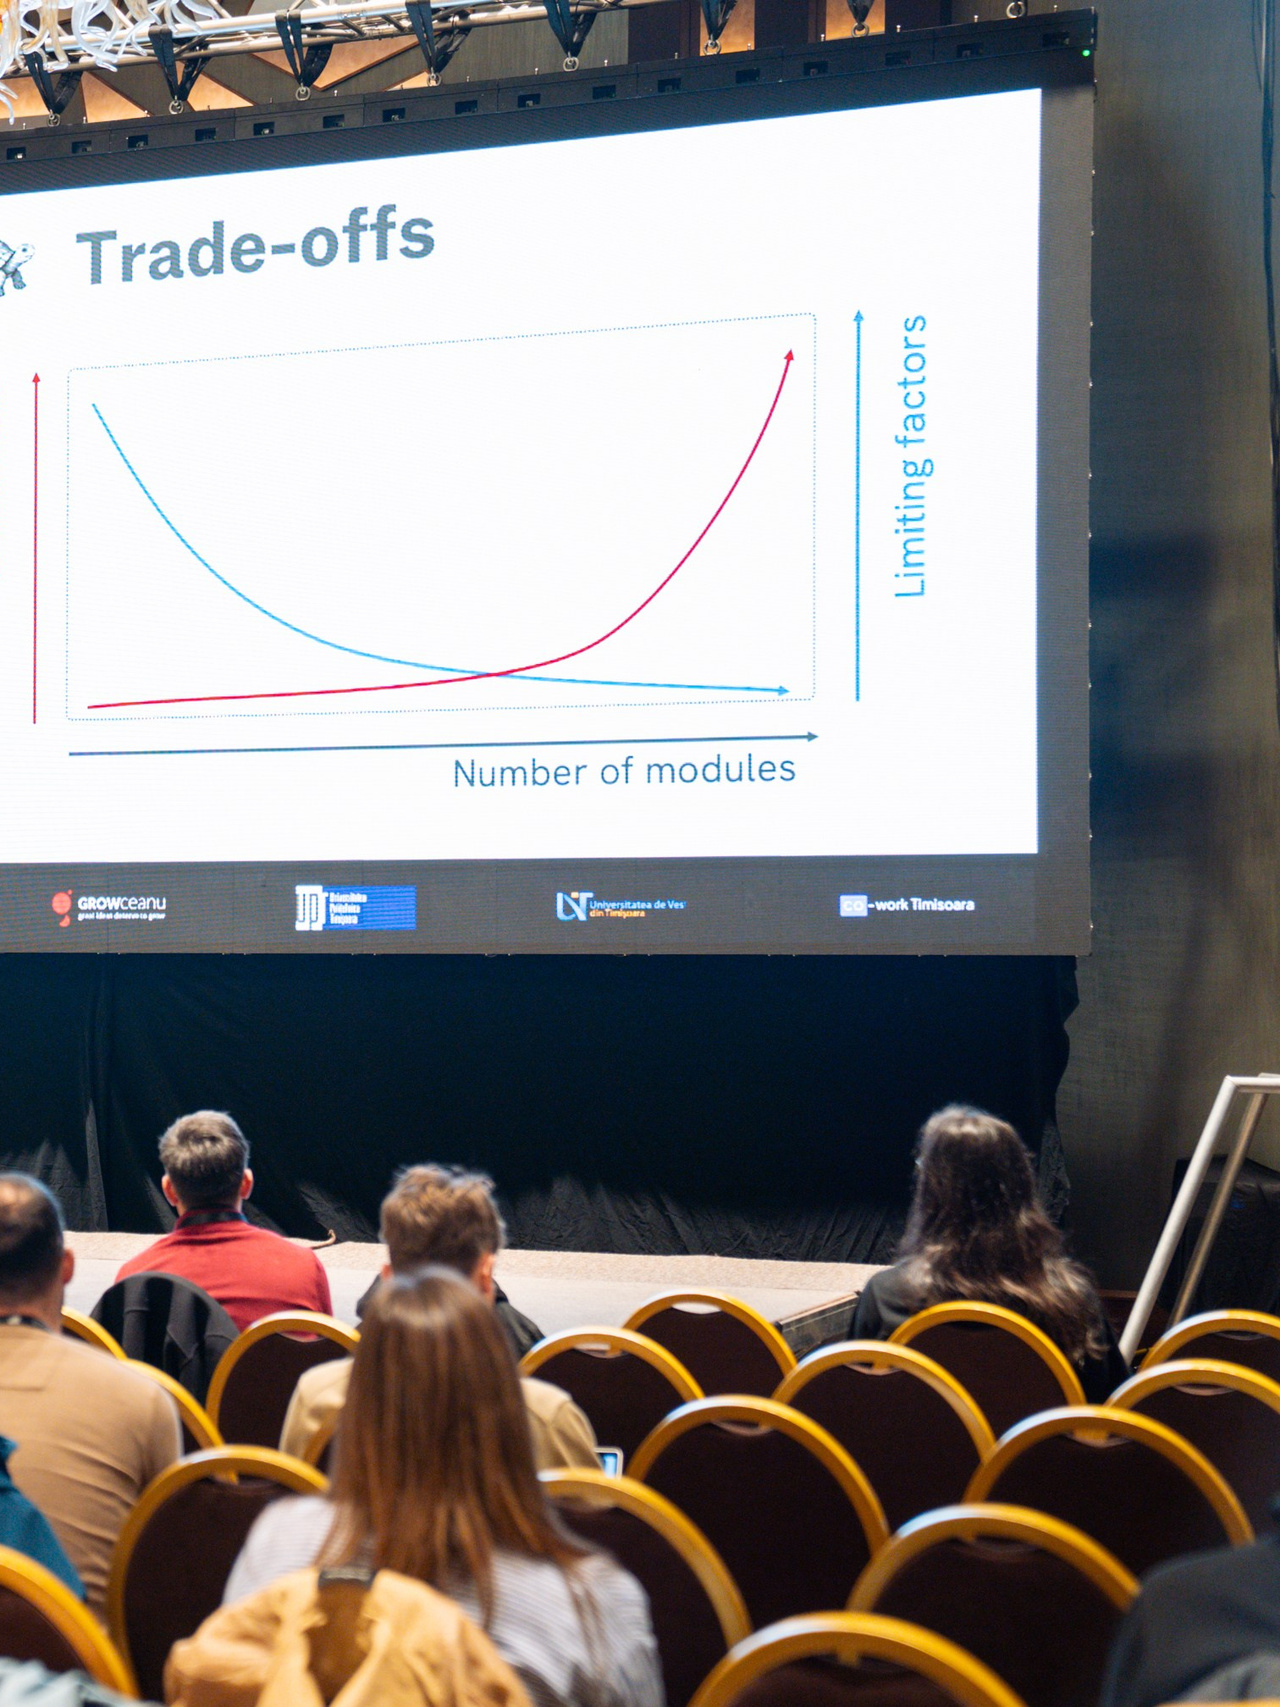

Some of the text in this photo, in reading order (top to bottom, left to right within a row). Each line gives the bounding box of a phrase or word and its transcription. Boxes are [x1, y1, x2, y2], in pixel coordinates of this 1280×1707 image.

[76, 204, 434, 284] Trade-offs
[895, 316, 933, 597] Limiting factors
[455, 753, 795, 787] Number of modules
[78, 897, 166, 910] GROWceanu
[653, 900, 666, 909] de
[910, 898, 975, 911] Timisoara
